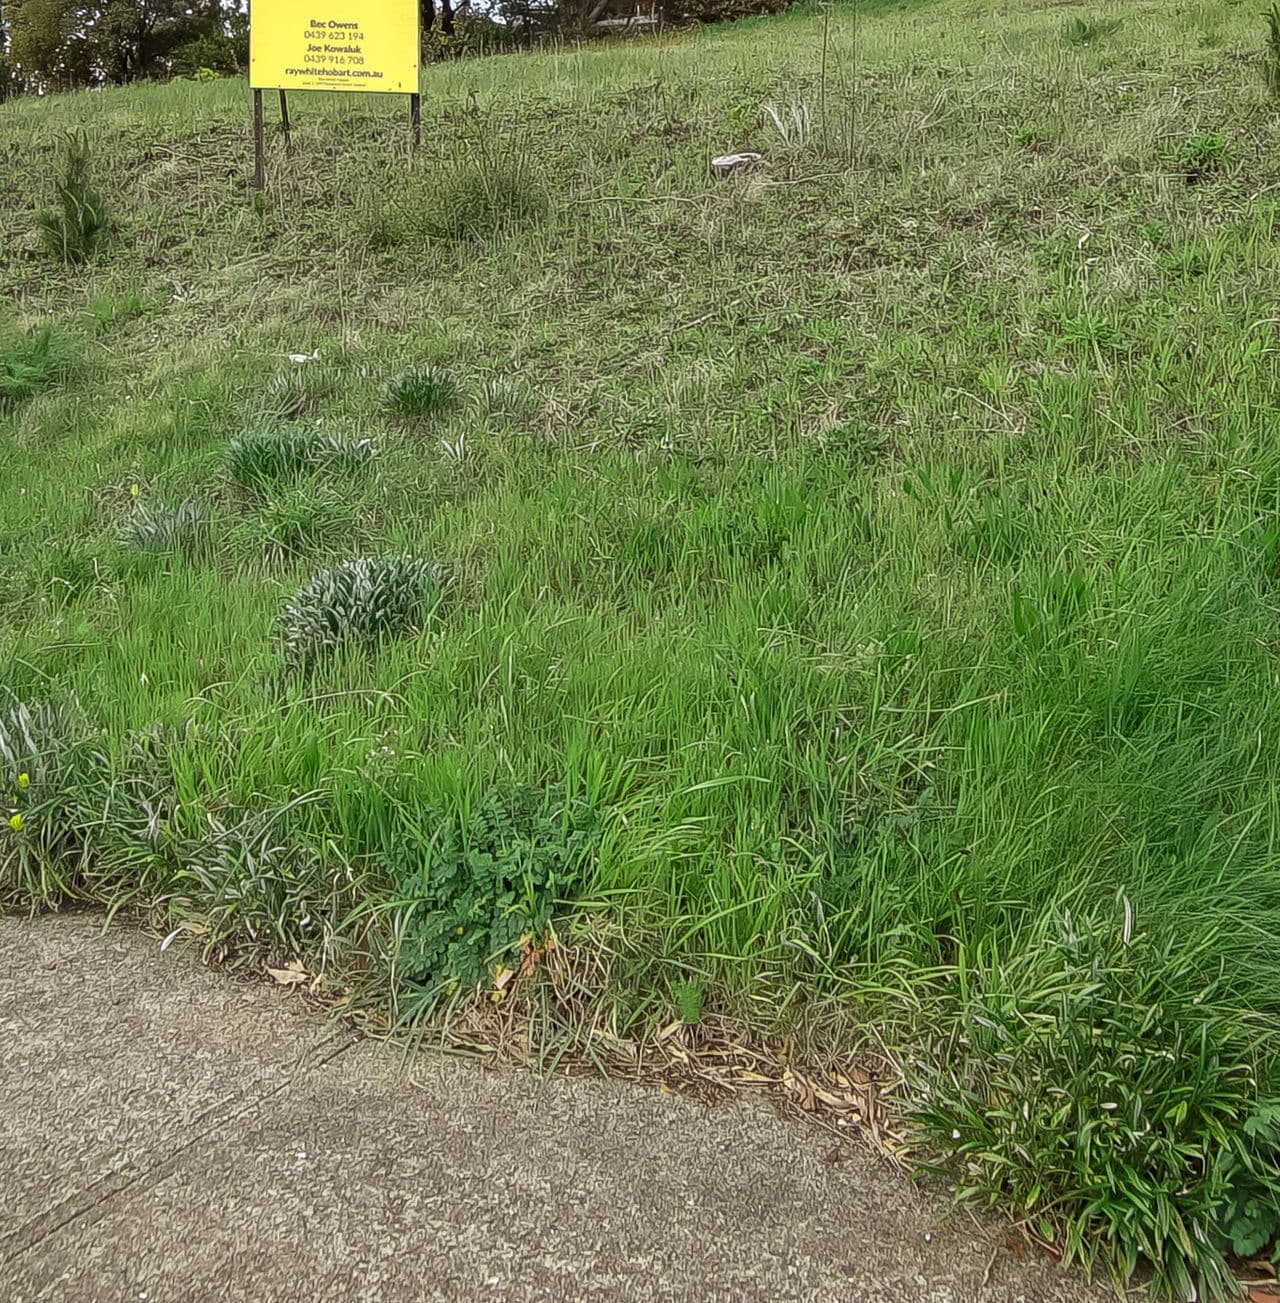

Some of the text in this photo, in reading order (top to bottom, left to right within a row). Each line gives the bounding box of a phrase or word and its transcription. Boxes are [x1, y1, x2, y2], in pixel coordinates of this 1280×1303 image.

[310, 19, 358, 30] Bec Owens
[304, 30, 364, 41] 0439 623 194
[307, 43, 322, 52] Joe
[304, 54, 326, 63] 0439
[285, 67, 383, 78] raywhitehobart.com.au
